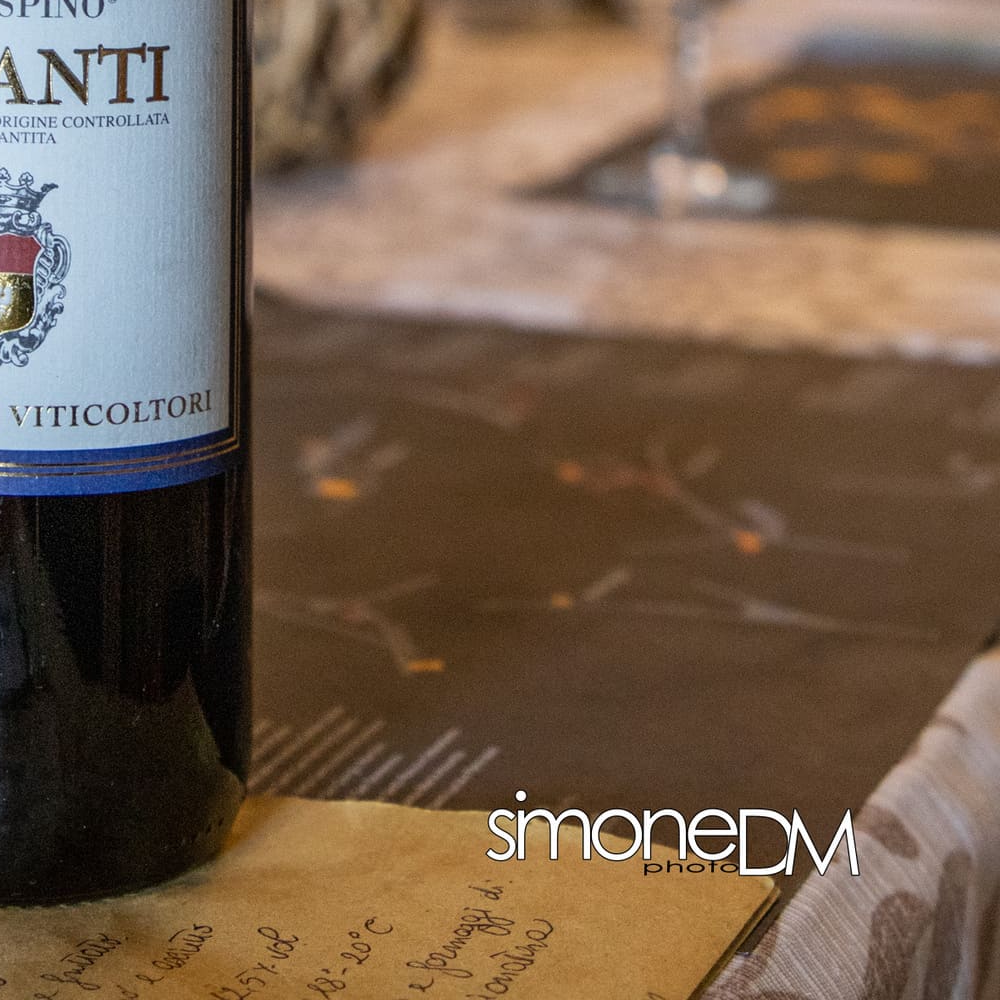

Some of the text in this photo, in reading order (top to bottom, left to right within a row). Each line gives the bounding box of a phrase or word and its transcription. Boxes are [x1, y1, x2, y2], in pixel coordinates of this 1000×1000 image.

[62, 112, 171, 129] CONTROLLATA
[9, 388, 213, 428] VITICOLTORI
[257, 926, 299, 959] vol
